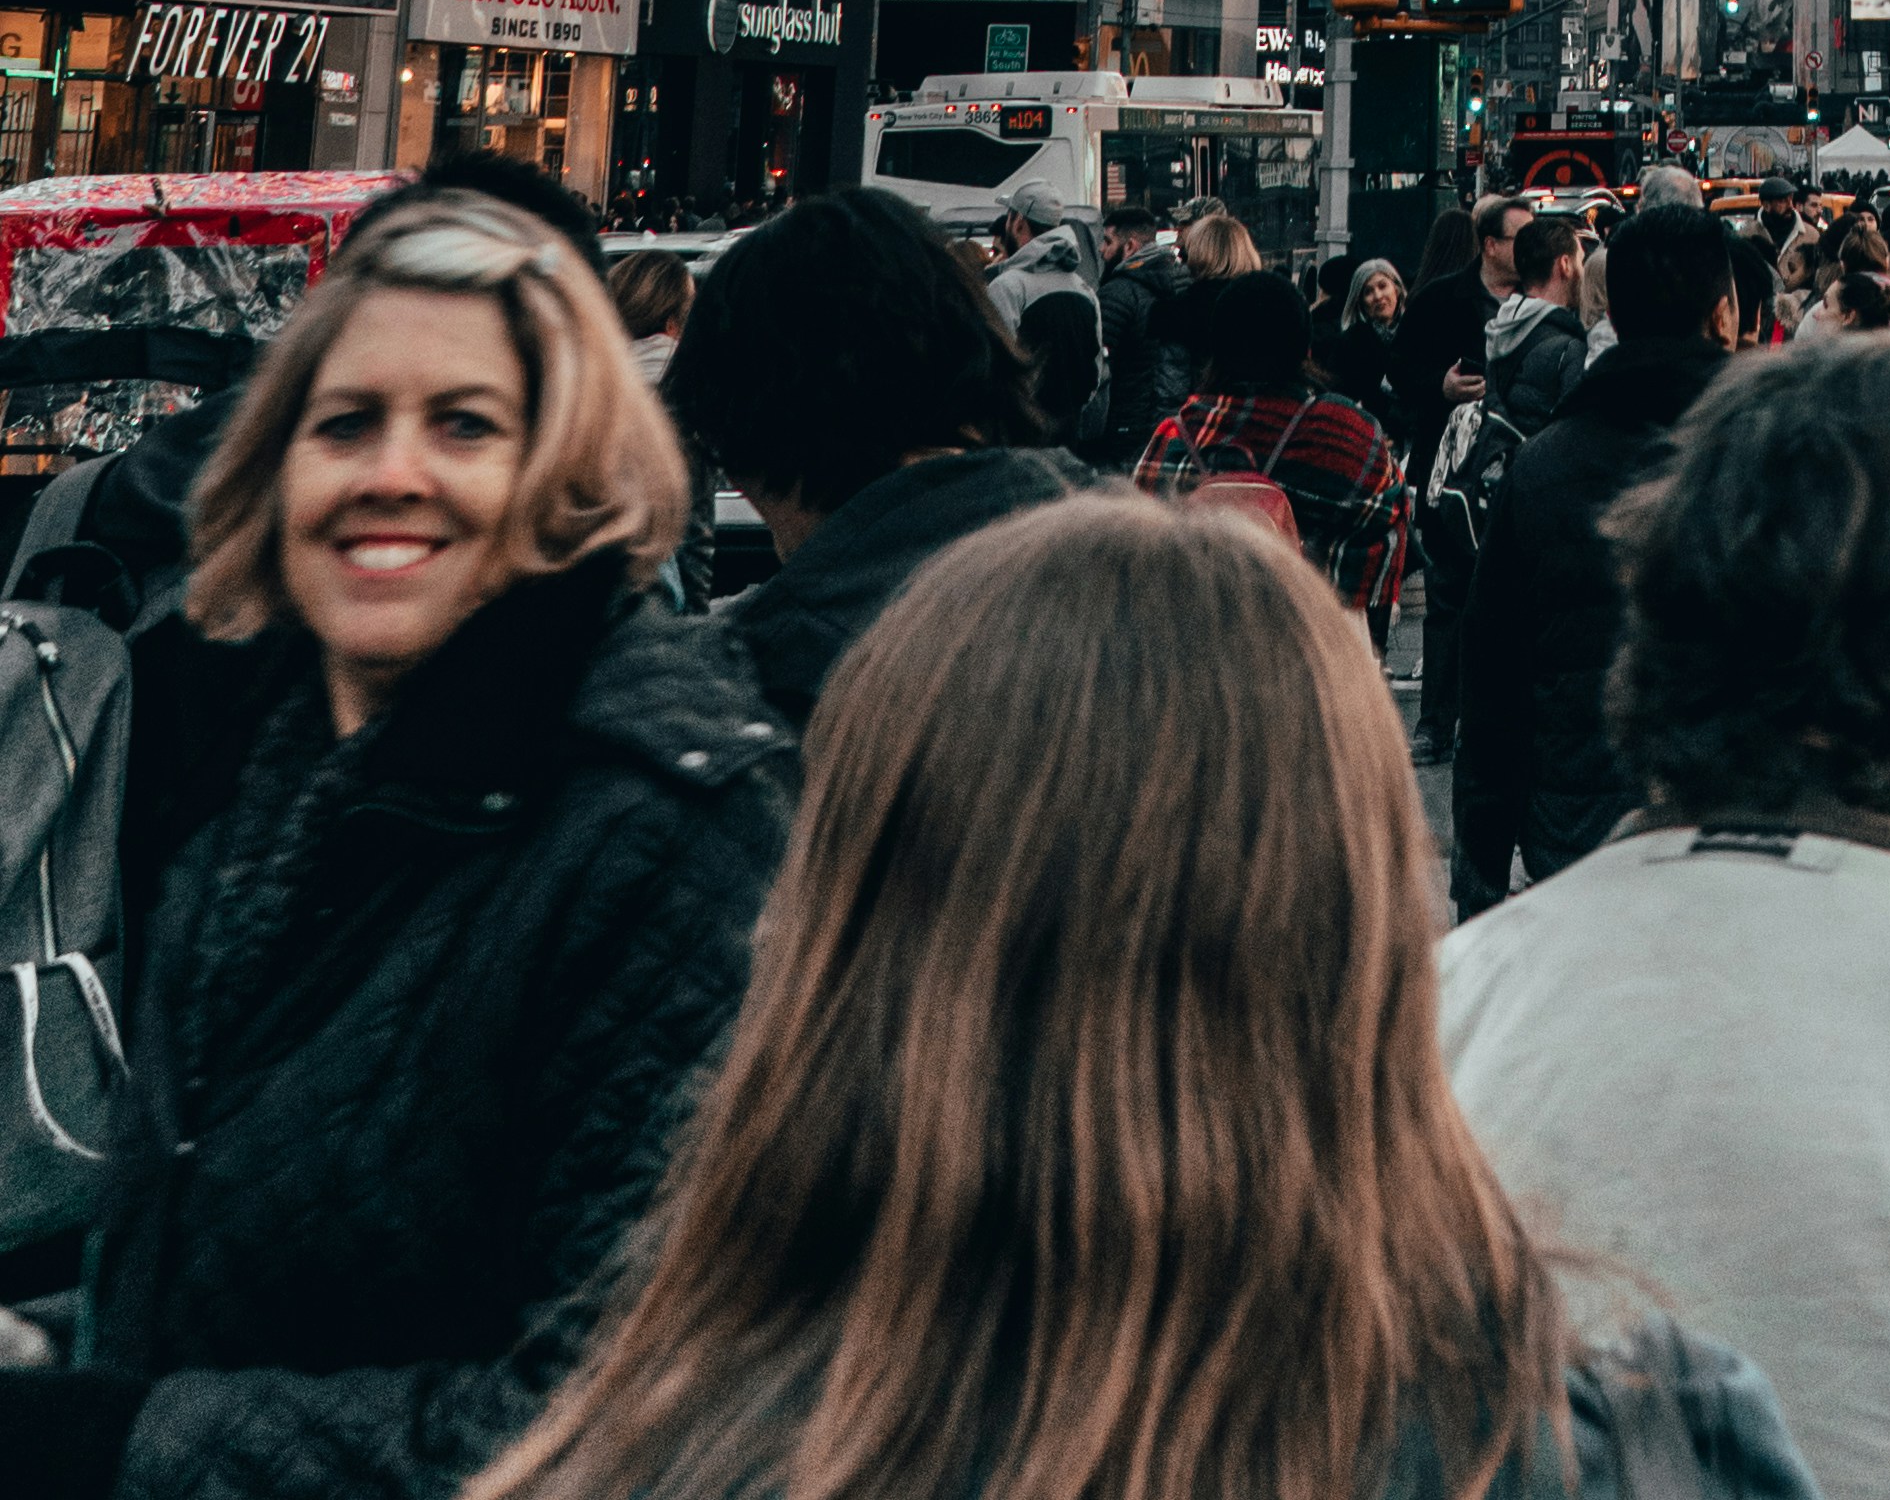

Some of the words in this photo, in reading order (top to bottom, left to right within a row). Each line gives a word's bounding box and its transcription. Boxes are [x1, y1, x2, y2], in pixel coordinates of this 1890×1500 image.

[491, 17, 539, 39] SINCE
[545, 20, 581, 42] 1890
[126, 1, 289, 83] FOREVER
[285, 16, 331, 84] 21
[992, 59, 1021, 70] South
[913, 112, 928, 121] York
[928, 112, 942, 121] City
[964, 111, 1001, 125] 3862
